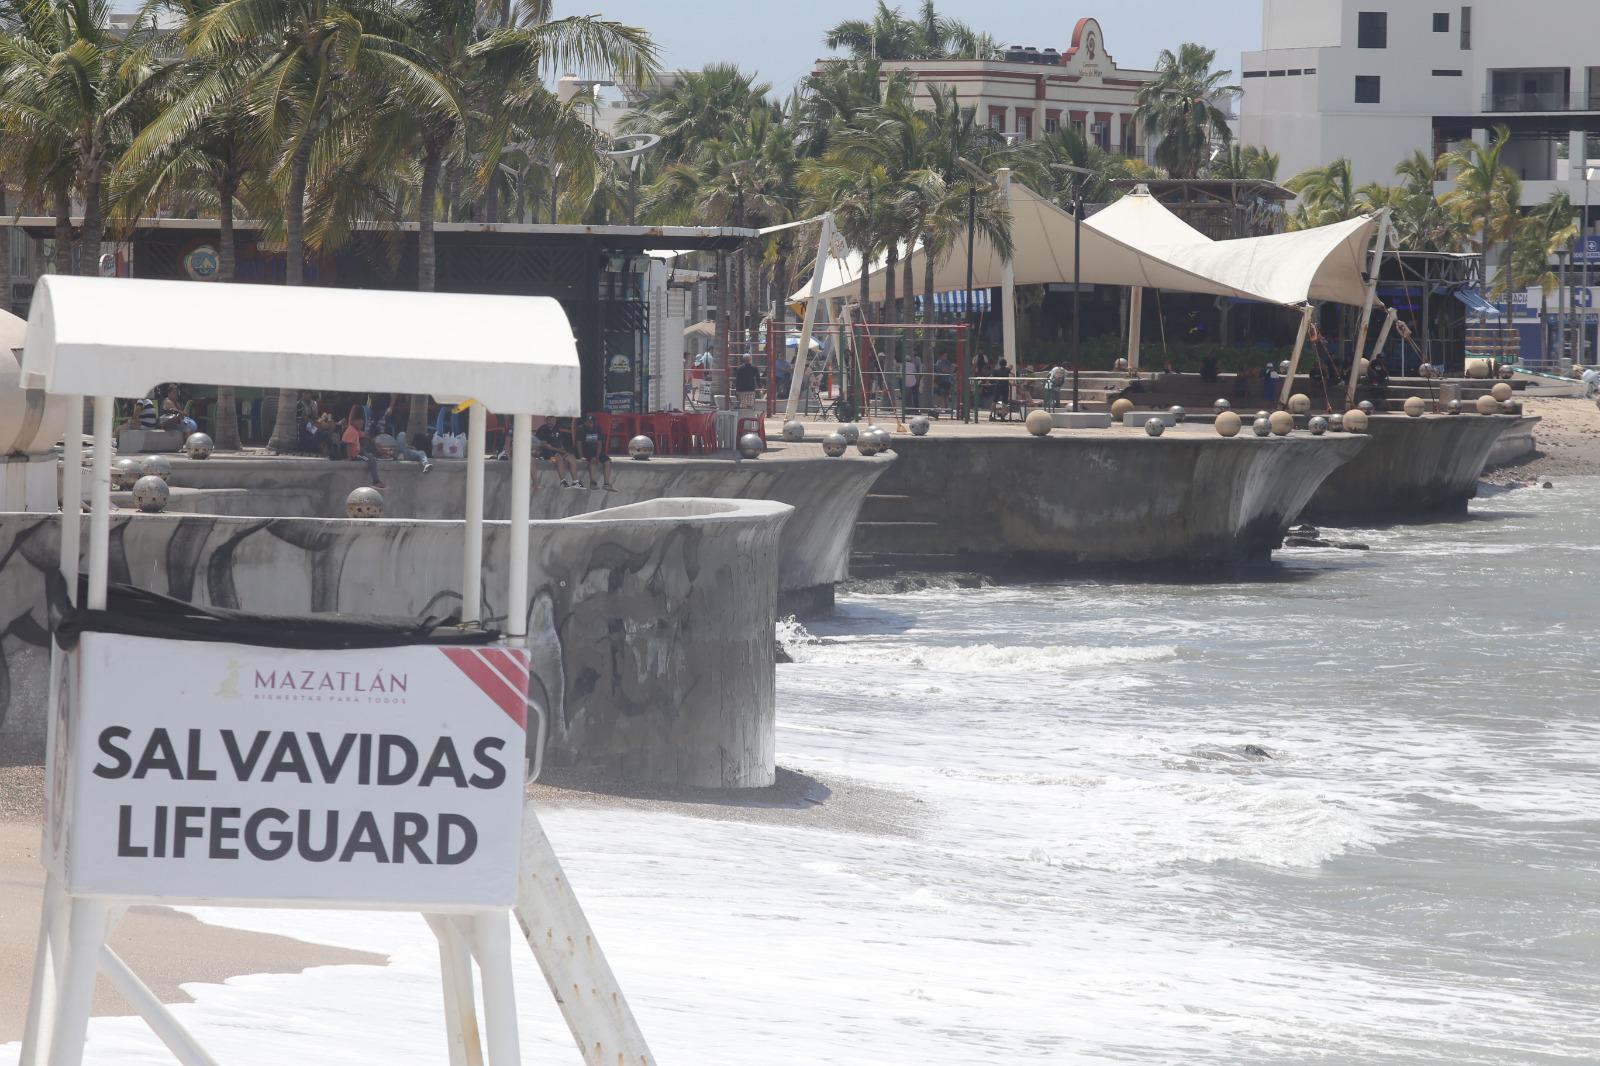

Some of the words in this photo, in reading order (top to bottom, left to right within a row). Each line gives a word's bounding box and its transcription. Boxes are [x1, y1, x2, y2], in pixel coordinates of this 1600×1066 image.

[255, 668, 407, 693] MAZATLÁN
[92, 725, 507, 790] SALVAVIDAS
[117, 804, 478, 865] LIFEGUARD
